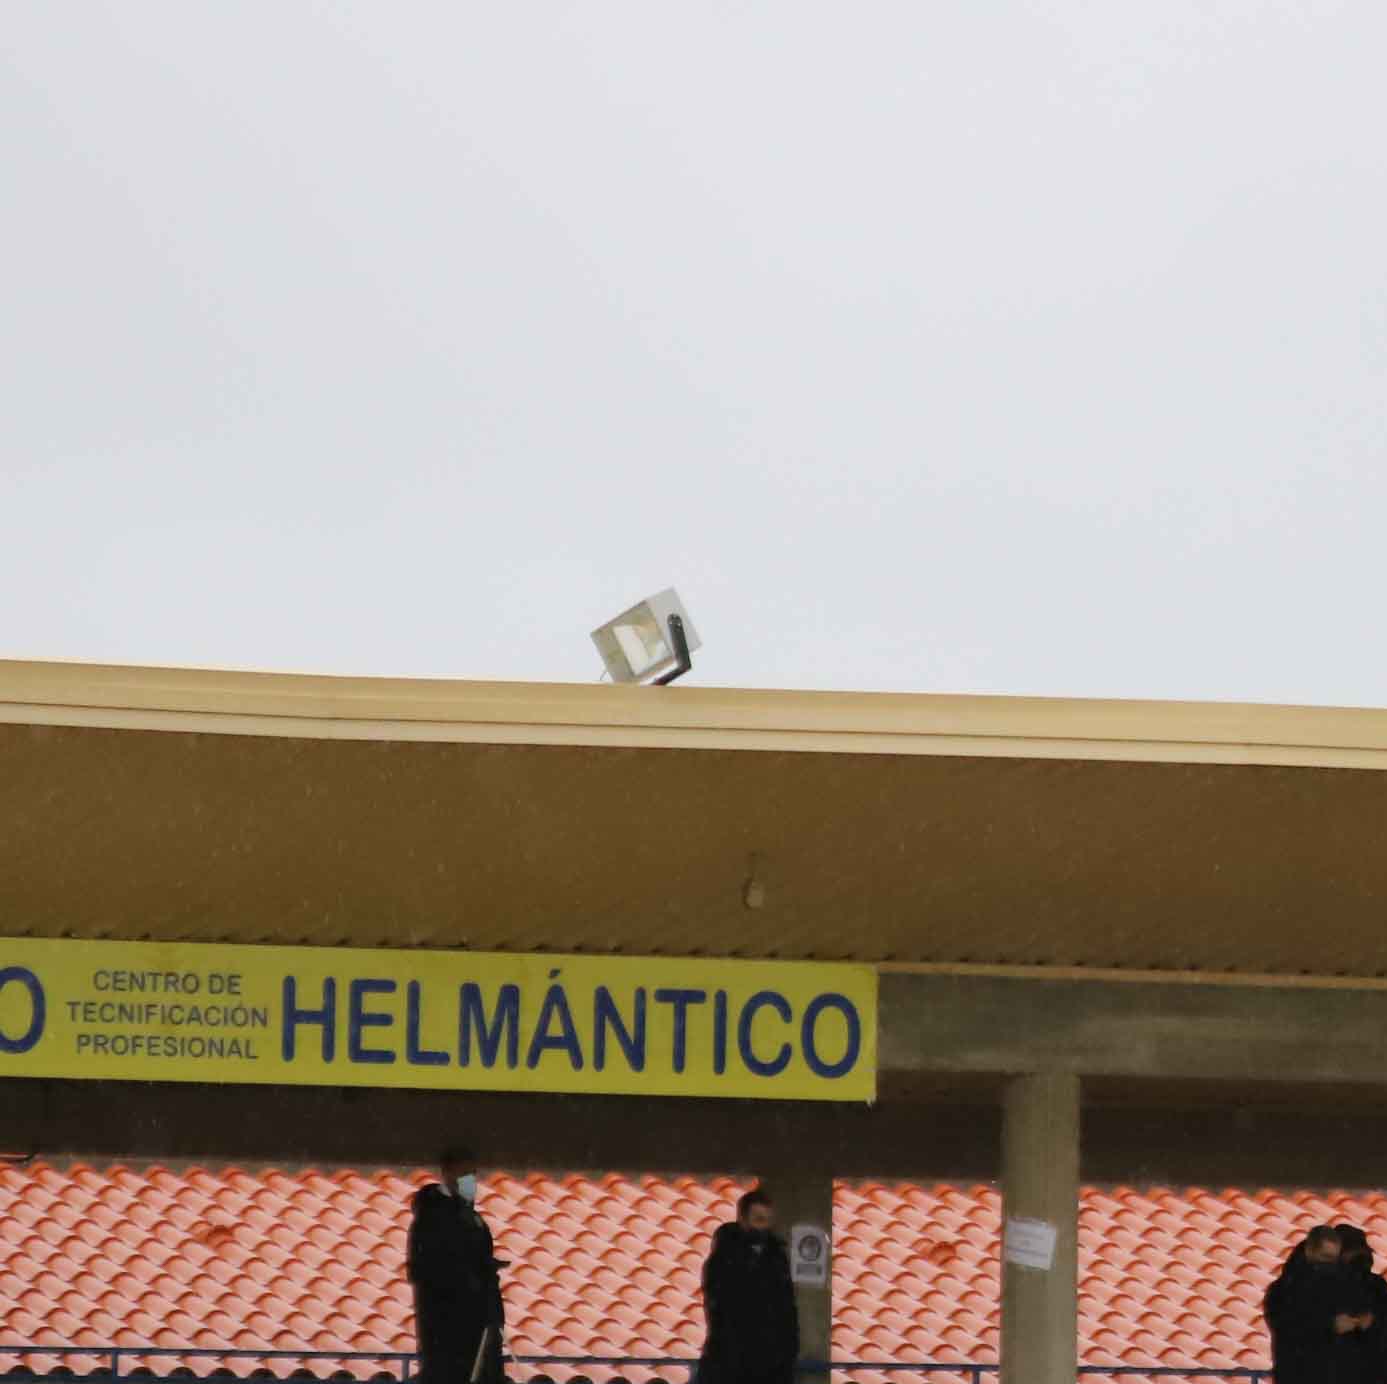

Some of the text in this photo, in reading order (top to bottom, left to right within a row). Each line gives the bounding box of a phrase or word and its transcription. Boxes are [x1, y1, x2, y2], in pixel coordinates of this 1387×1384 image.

[93, 971, 242, 995] CENTRO DE
[66, 1000, 269, 1029] TECNIFICACIÓN
[280, 968, 862, 1080] HELMÁNTICO
[75, 1033, 260, 1060] PROFESIONAL
